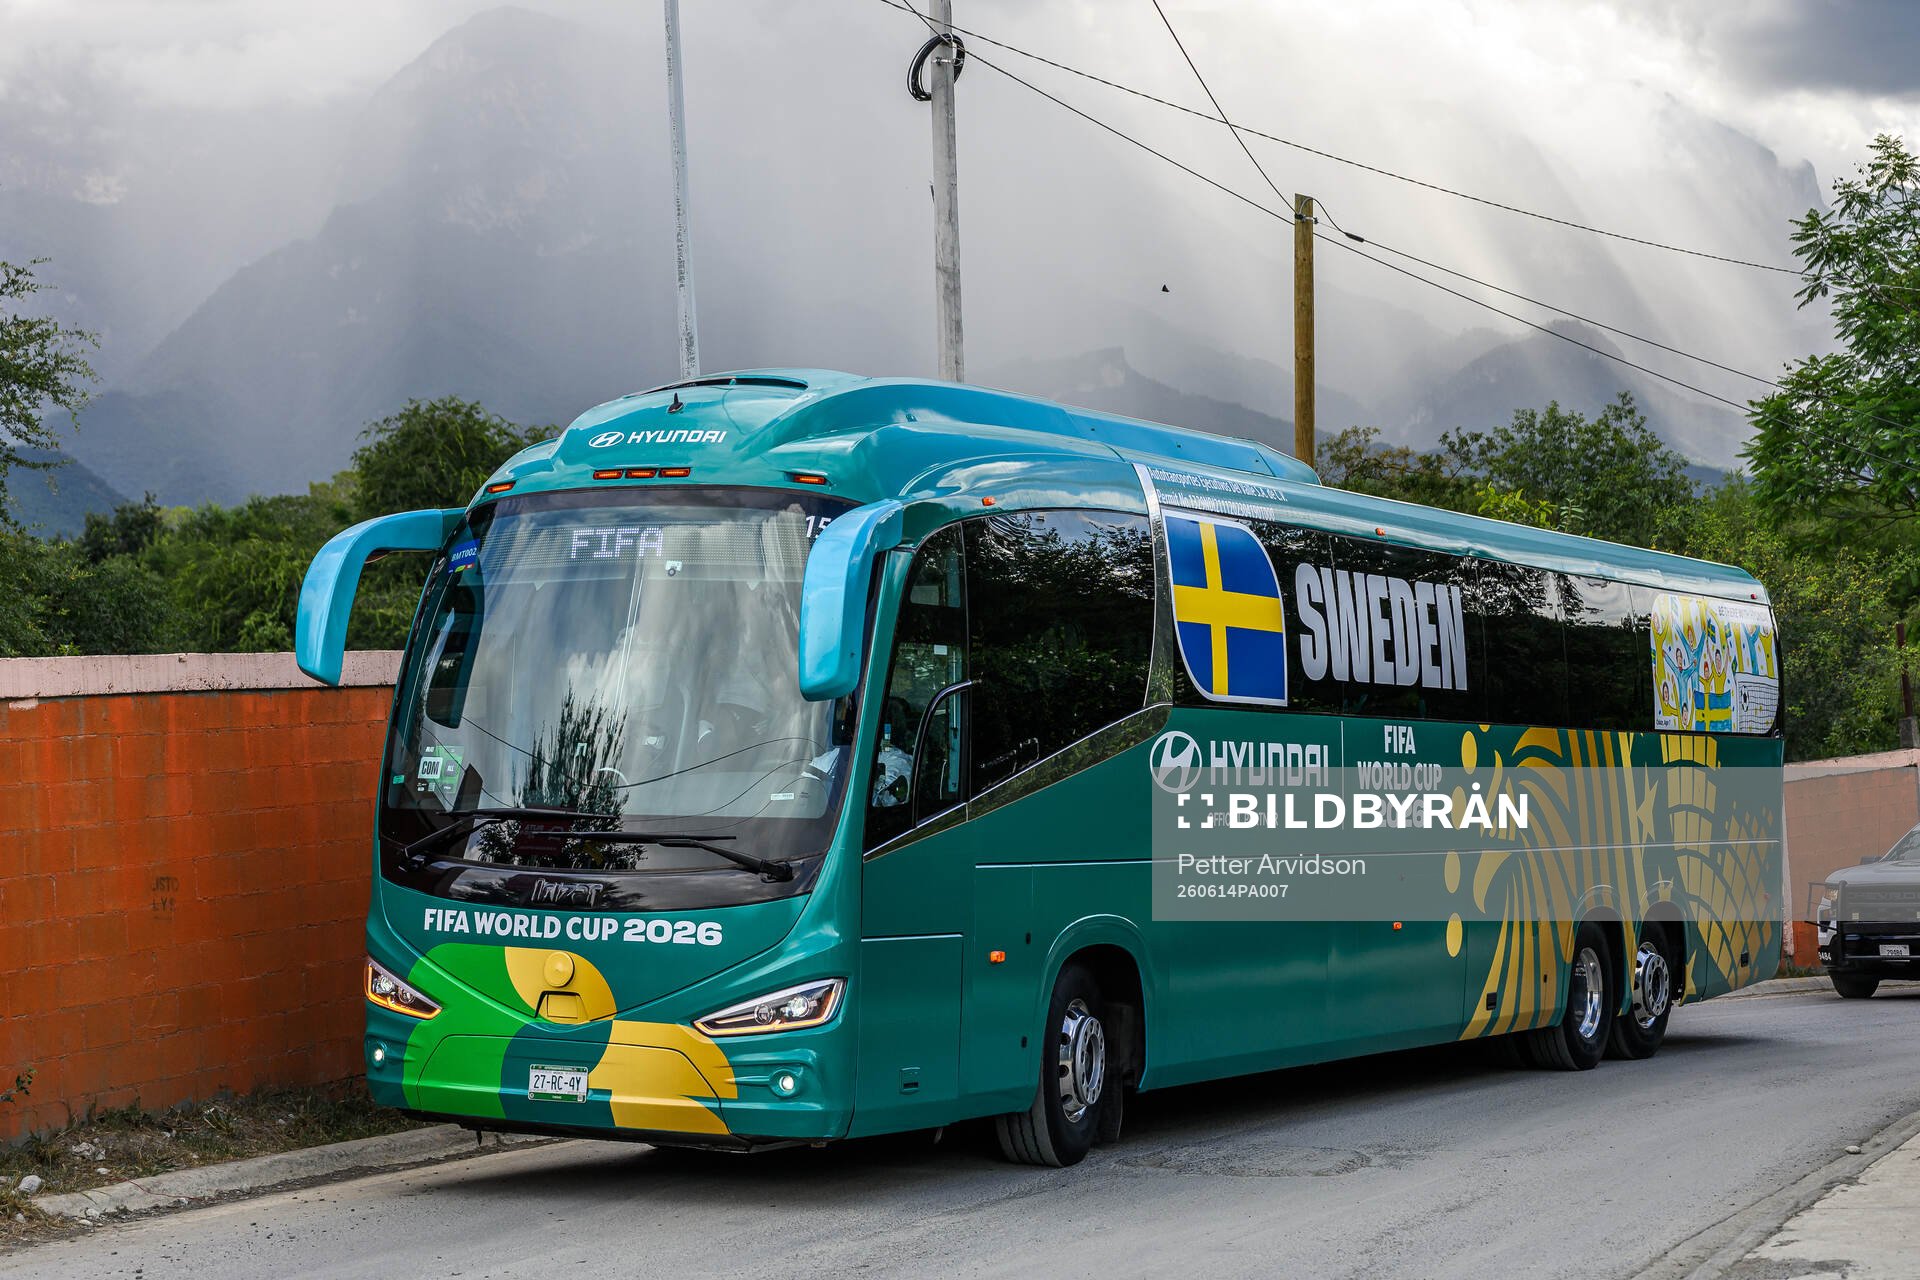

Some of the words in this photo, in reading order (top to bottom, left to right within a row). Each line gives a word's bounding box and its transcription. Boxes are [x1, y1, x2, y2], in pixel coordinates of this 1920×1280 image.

[627, 430, 726, 444] HYUNDAI
[571, 527, 664, 559] FIFA
[1295, 563, 1467, 691] SWEDEN
[1383, 725, 1416, 754] FIFA
[1210, 740, 1329, 788] HYUNDAI
[1357, 760, 1413, 790] WORLD
[1415, 763, 1442, 791] CUP
[423, 908, 469, 934] FIFA
[473, 911, 562, 939] WORLD
[566, 916, 619, 941] CUP
[623, 918, 723, 946] 2026
[533, 1074, 582, 1091] 27-RC-4Y
